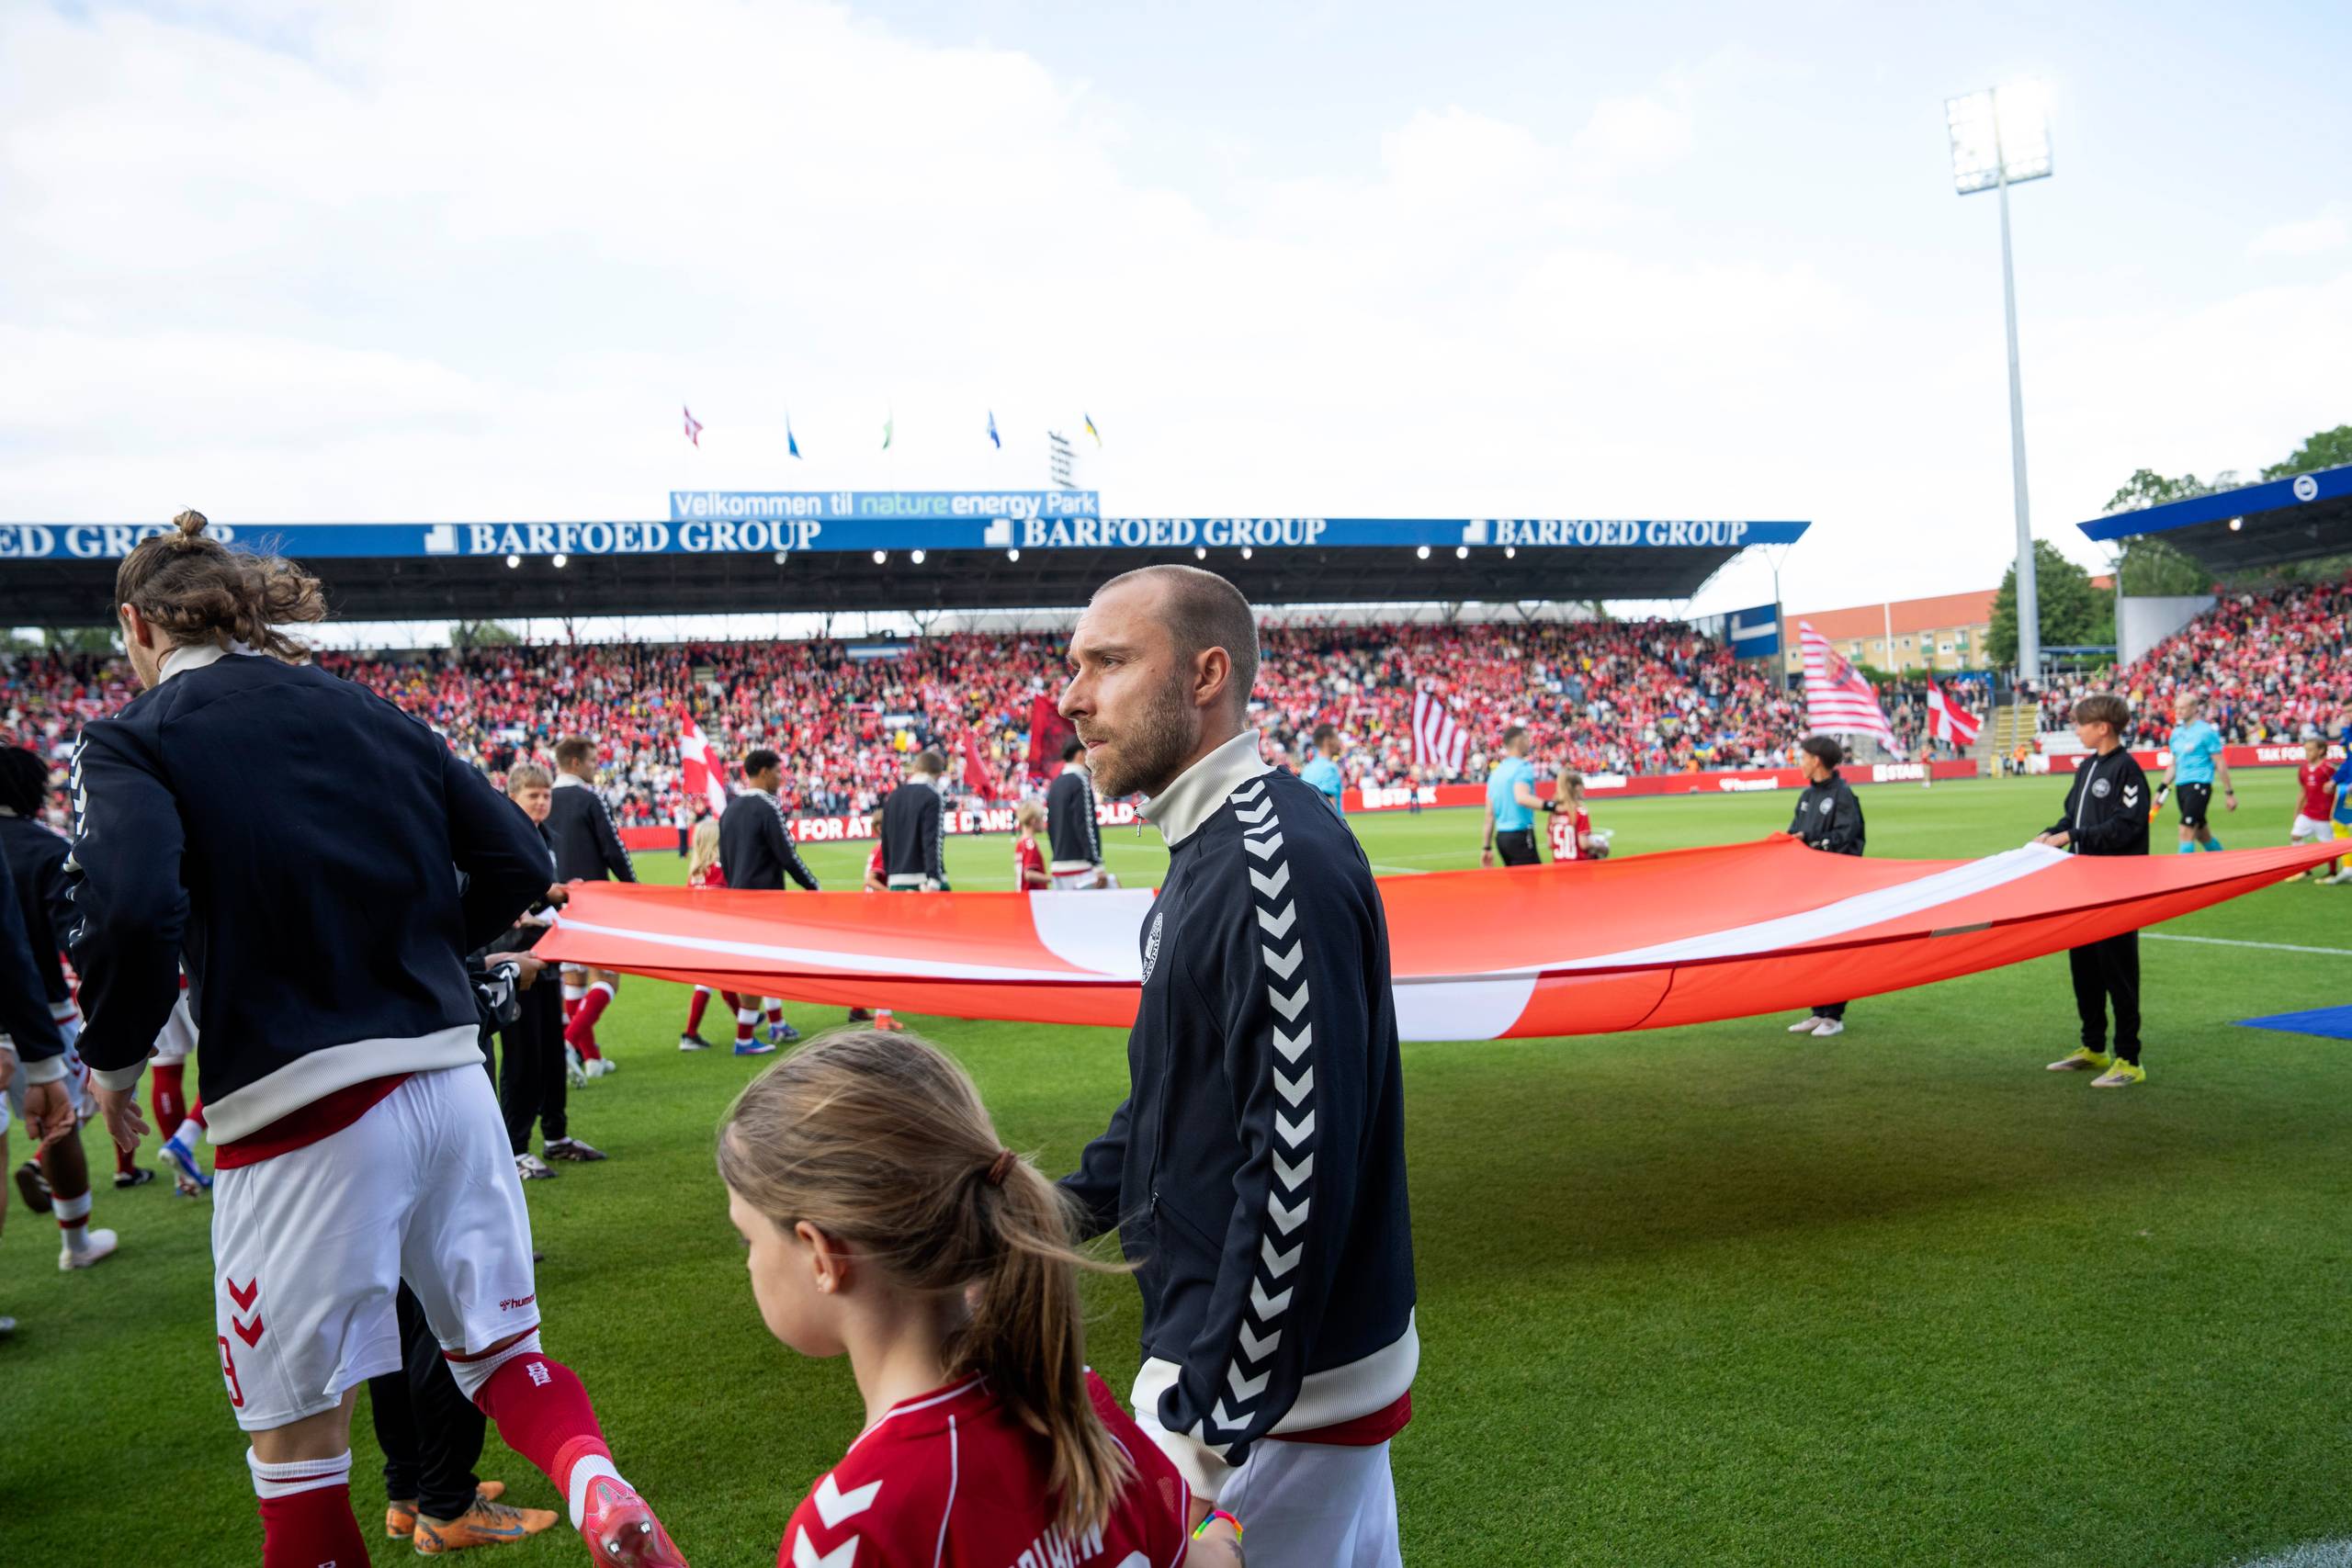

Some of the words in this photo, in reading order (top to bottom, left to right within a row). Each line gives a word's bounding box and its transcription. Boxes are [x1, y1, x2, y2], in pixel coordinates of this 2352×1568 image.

[673, 493, 821, 515] Velkommen
[831, 491, 853, 515] til
[861, 494, 948, 514] nature
[951, 497, 1040, 518] energy
[1046, 493, 1096, 514] Park
[469, 523, 671, 554] BARFOED
[678, 520, 822, 551] GROUP
[1023, 519, 1196, 547] BARFOED
[1203, 518, 1327, 546] GROUP
[1495, 520, 1640, 546] BARFOED
[1645, 522, 1747, 546] GROUP
[797, 818, 843, 841] FOR
